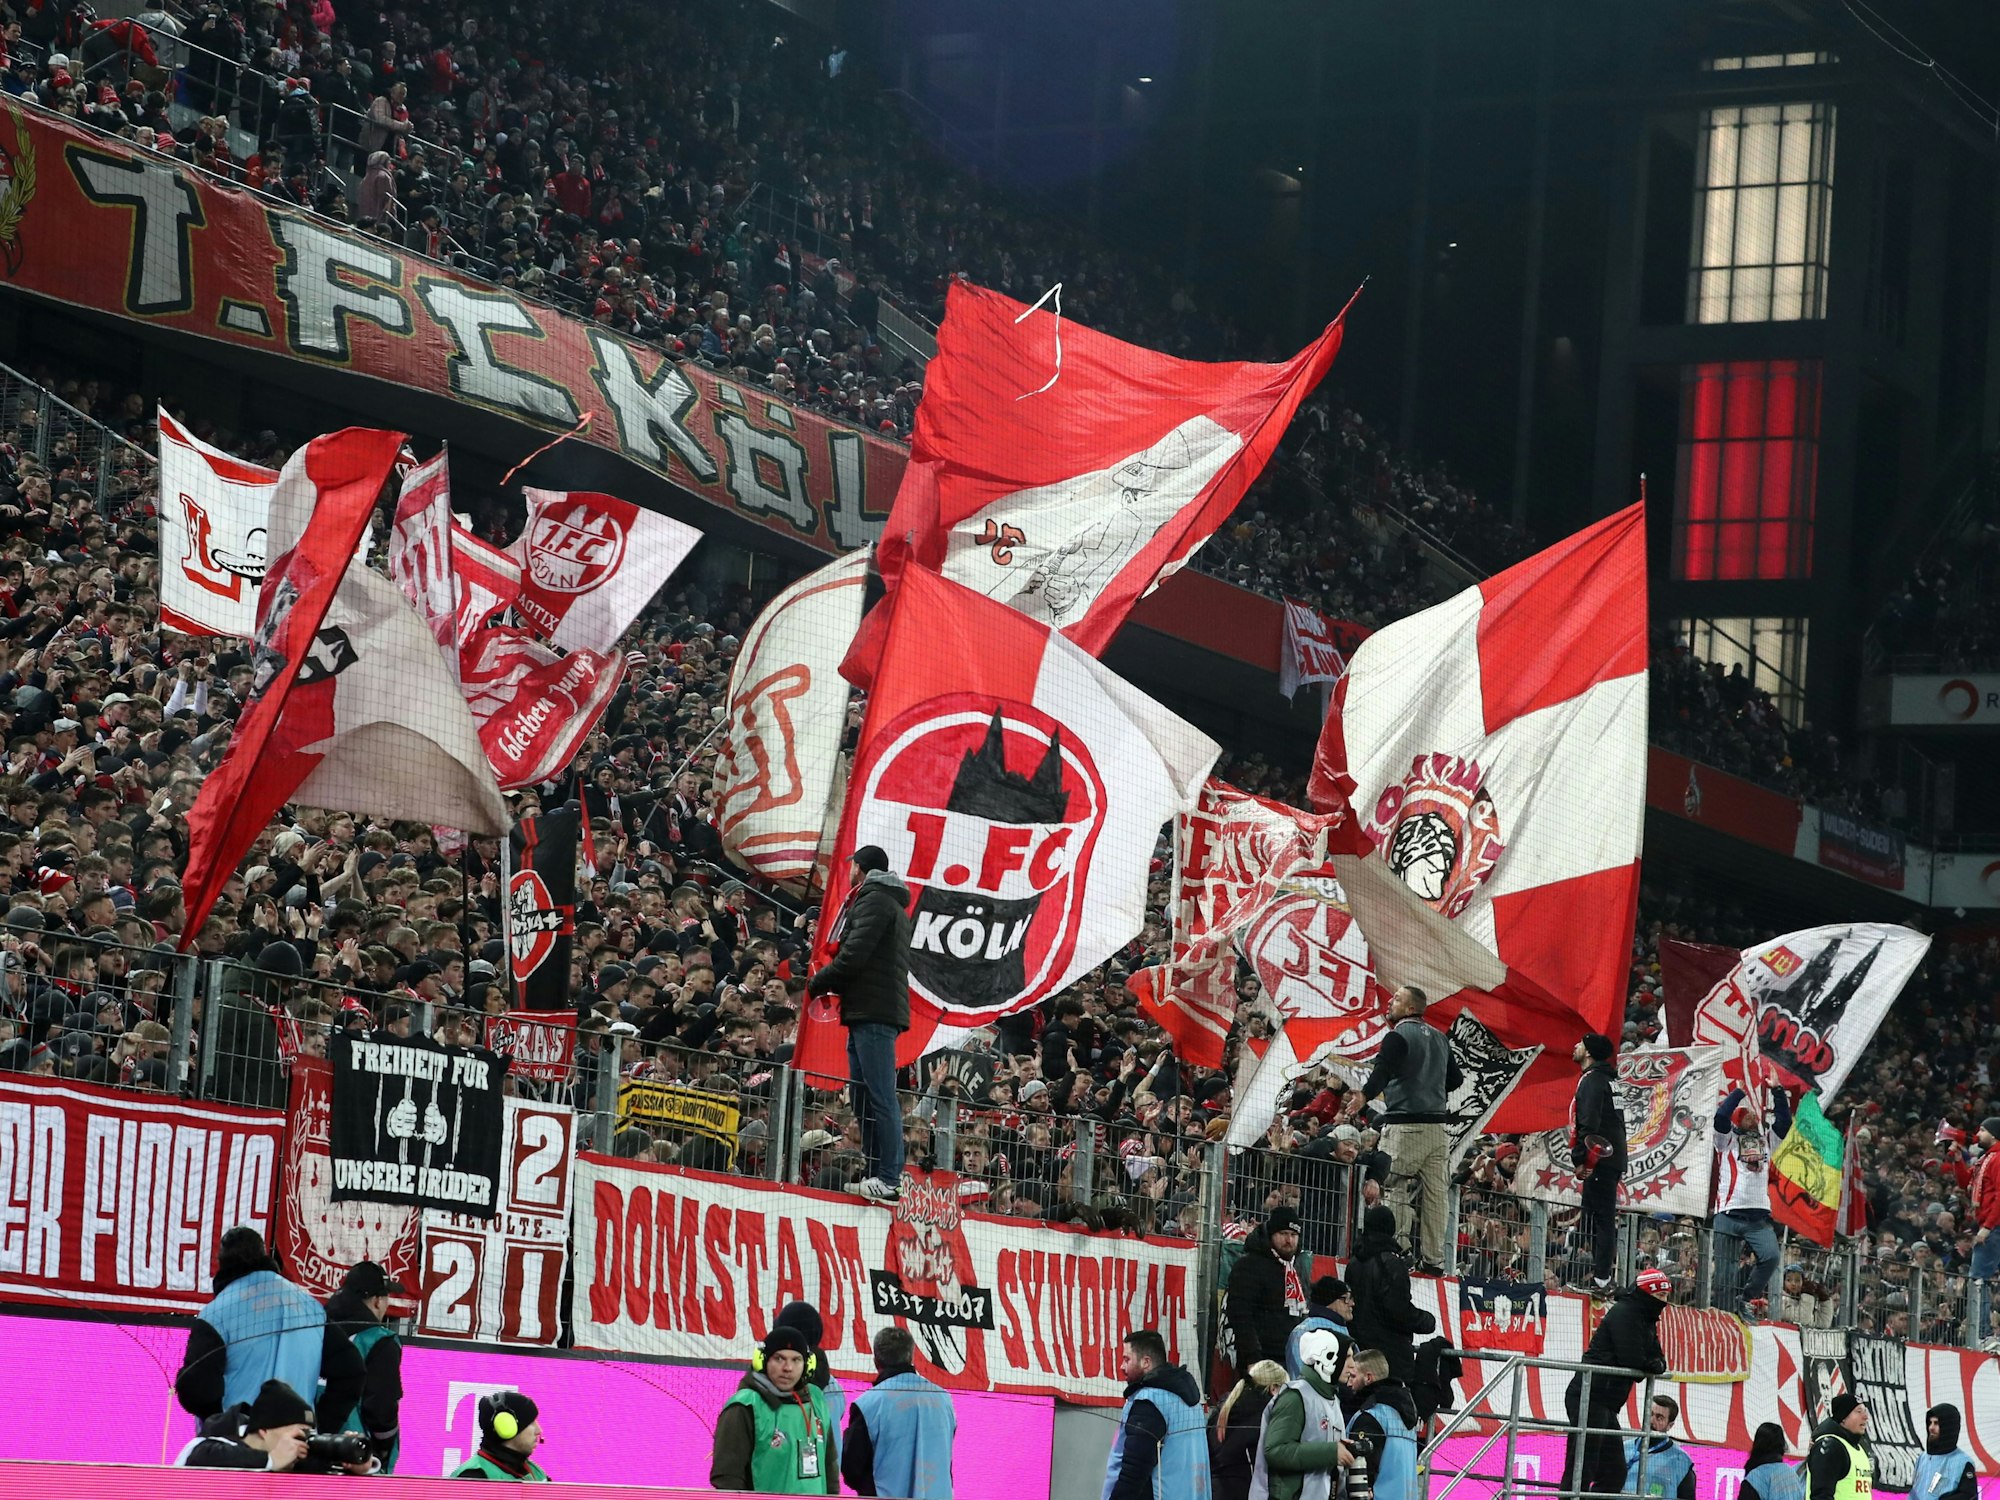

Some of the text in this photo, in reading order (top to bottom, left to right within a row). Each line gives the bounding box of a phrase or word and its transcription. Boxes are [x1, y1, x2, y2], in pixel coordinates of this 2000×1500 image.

[586, 325, 890, 553] KÖL
[539, 523, 608, 562] 1.FC
[516, 592, 560, 632] AOTIX
[497, 696, 555, 763] bleiben
[904, 810, 1074, 893] 1.FC
[909, 903, 1034, 961] KÖLN
[350, 1040, 490, 1091] FREIHEIT FÜR
[334, 1158, 492, 1206] UNSERE BRÜDER
[450, 1211, 544, 1239] REVOLTE
[590, 1180, 1187, 1382] DOMSTADT SYNDIKAT
